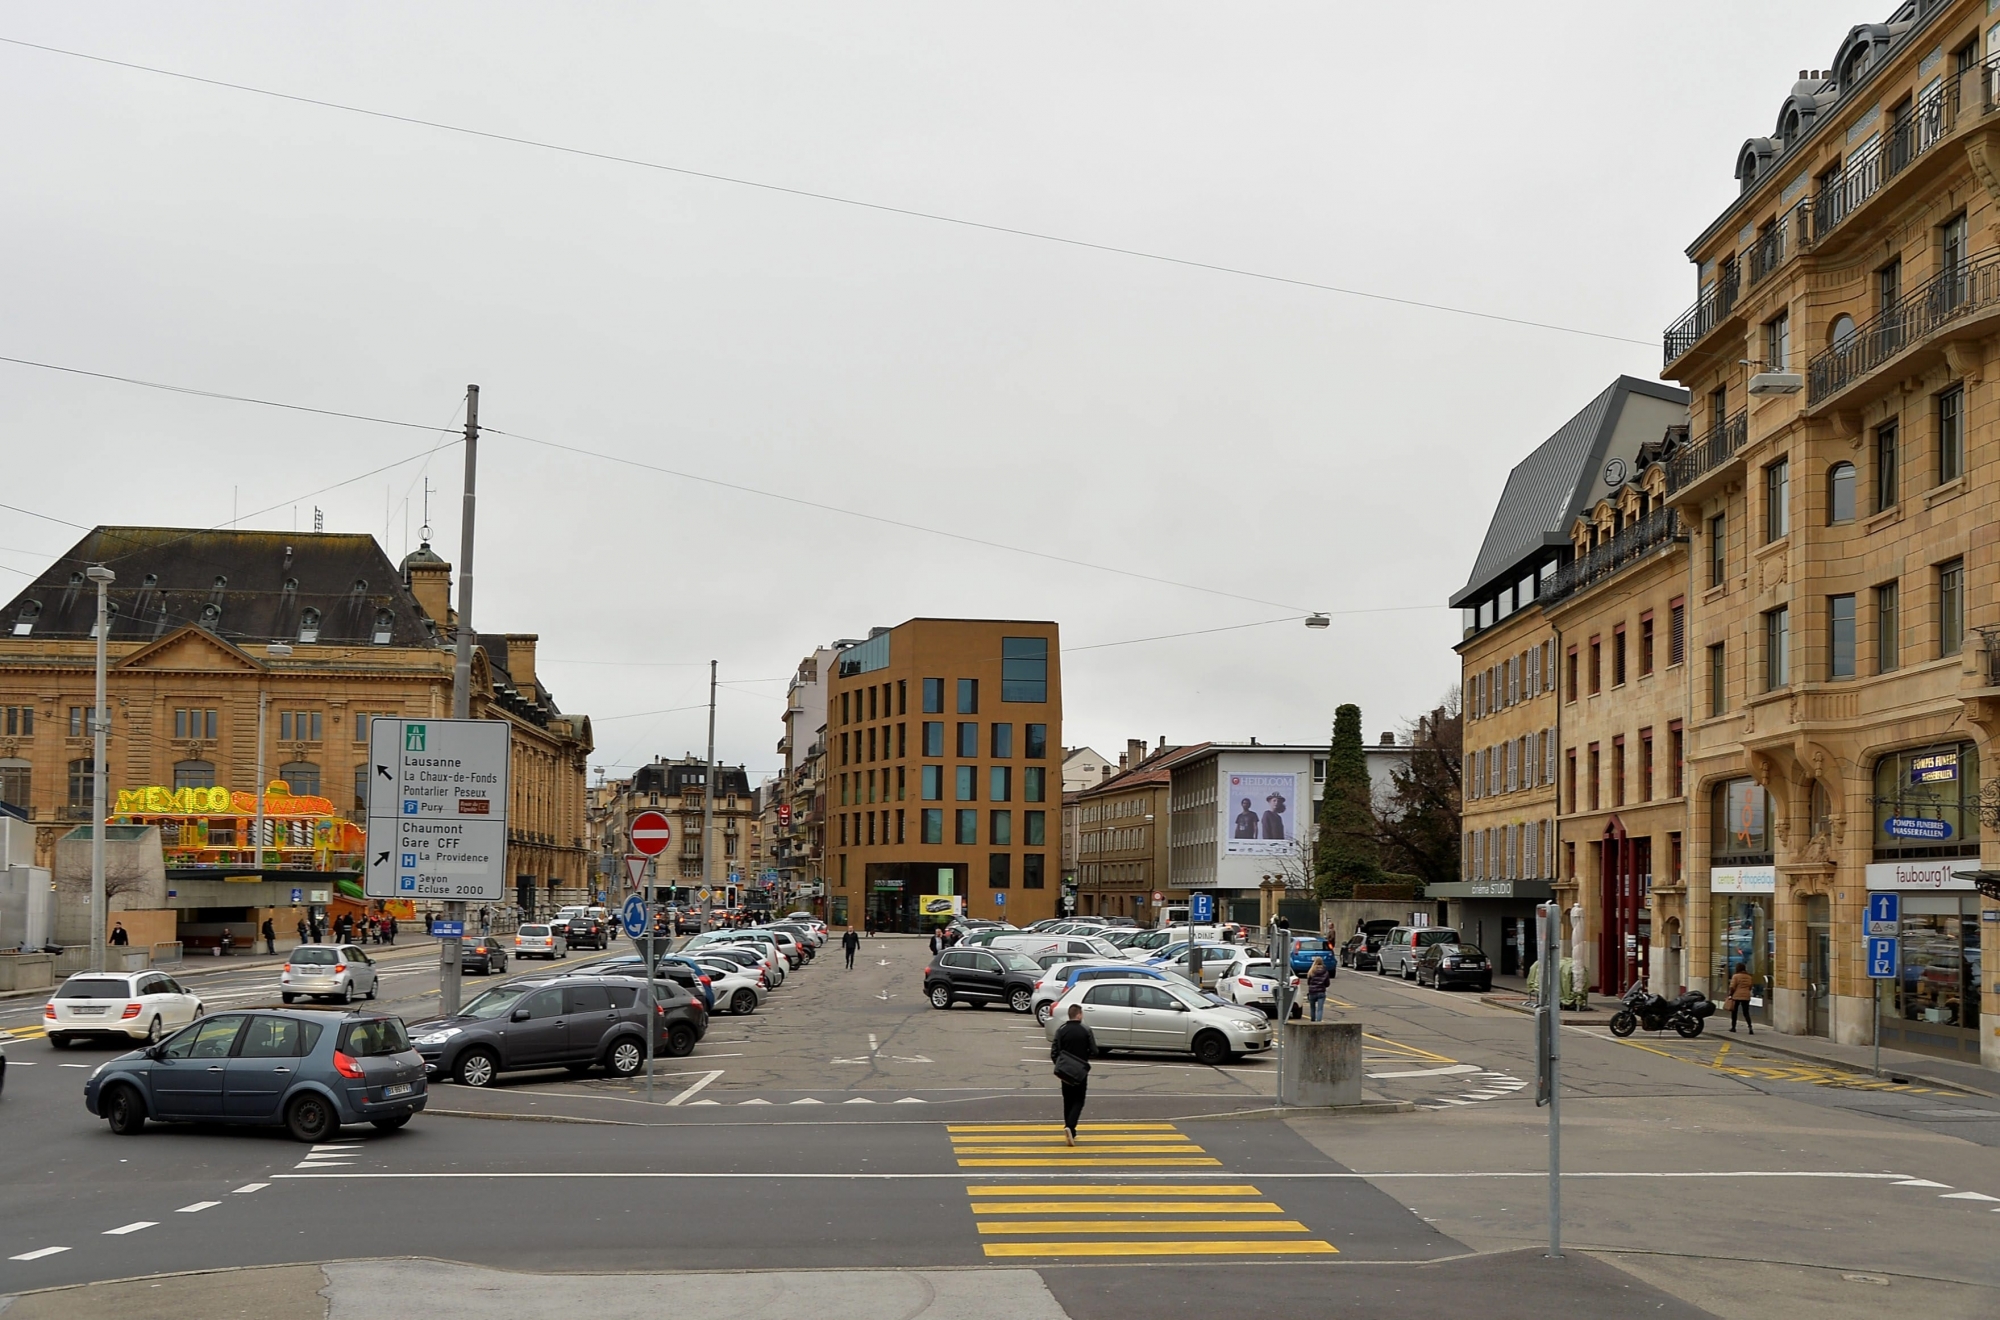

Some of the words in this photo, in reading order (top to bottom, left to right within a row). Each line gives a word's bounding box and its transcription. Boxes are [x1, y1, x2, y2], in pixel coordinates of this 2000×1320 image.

[404, 756, 462, 767] Lausanne
[404, 770, 415, 781] La
[420, 771, 498, 784] Chaux-de-Fonds
[403, 785, 449, 796] Pontarlier
[454, 786, 487, 797] Peseux
[118, 786, 230, 813] MEXICO
[421, 802, 444, 813] Pury
[781, 806, 789, 825] CIC
[402, 822, 463, 834] Chaumont
[1893, 819, 1916, 828] POMPES
[1916, 820, 1944, 830] FUNEBRES
[1893, 827, 1944, 837] WASSERFALLEN
[402, 837, 430, 848] Gare
[437, 838, 461, 849] CFF
[419, 852, 430, 861] La
[436, 852, 489, 863] Providence
[419, 874, 448, 884] Seyon
[1896, 866, 1951, 887] faubourg11
[418, 885, 450, 894] Ecluse
[456, 885, 484, 895] 2000
